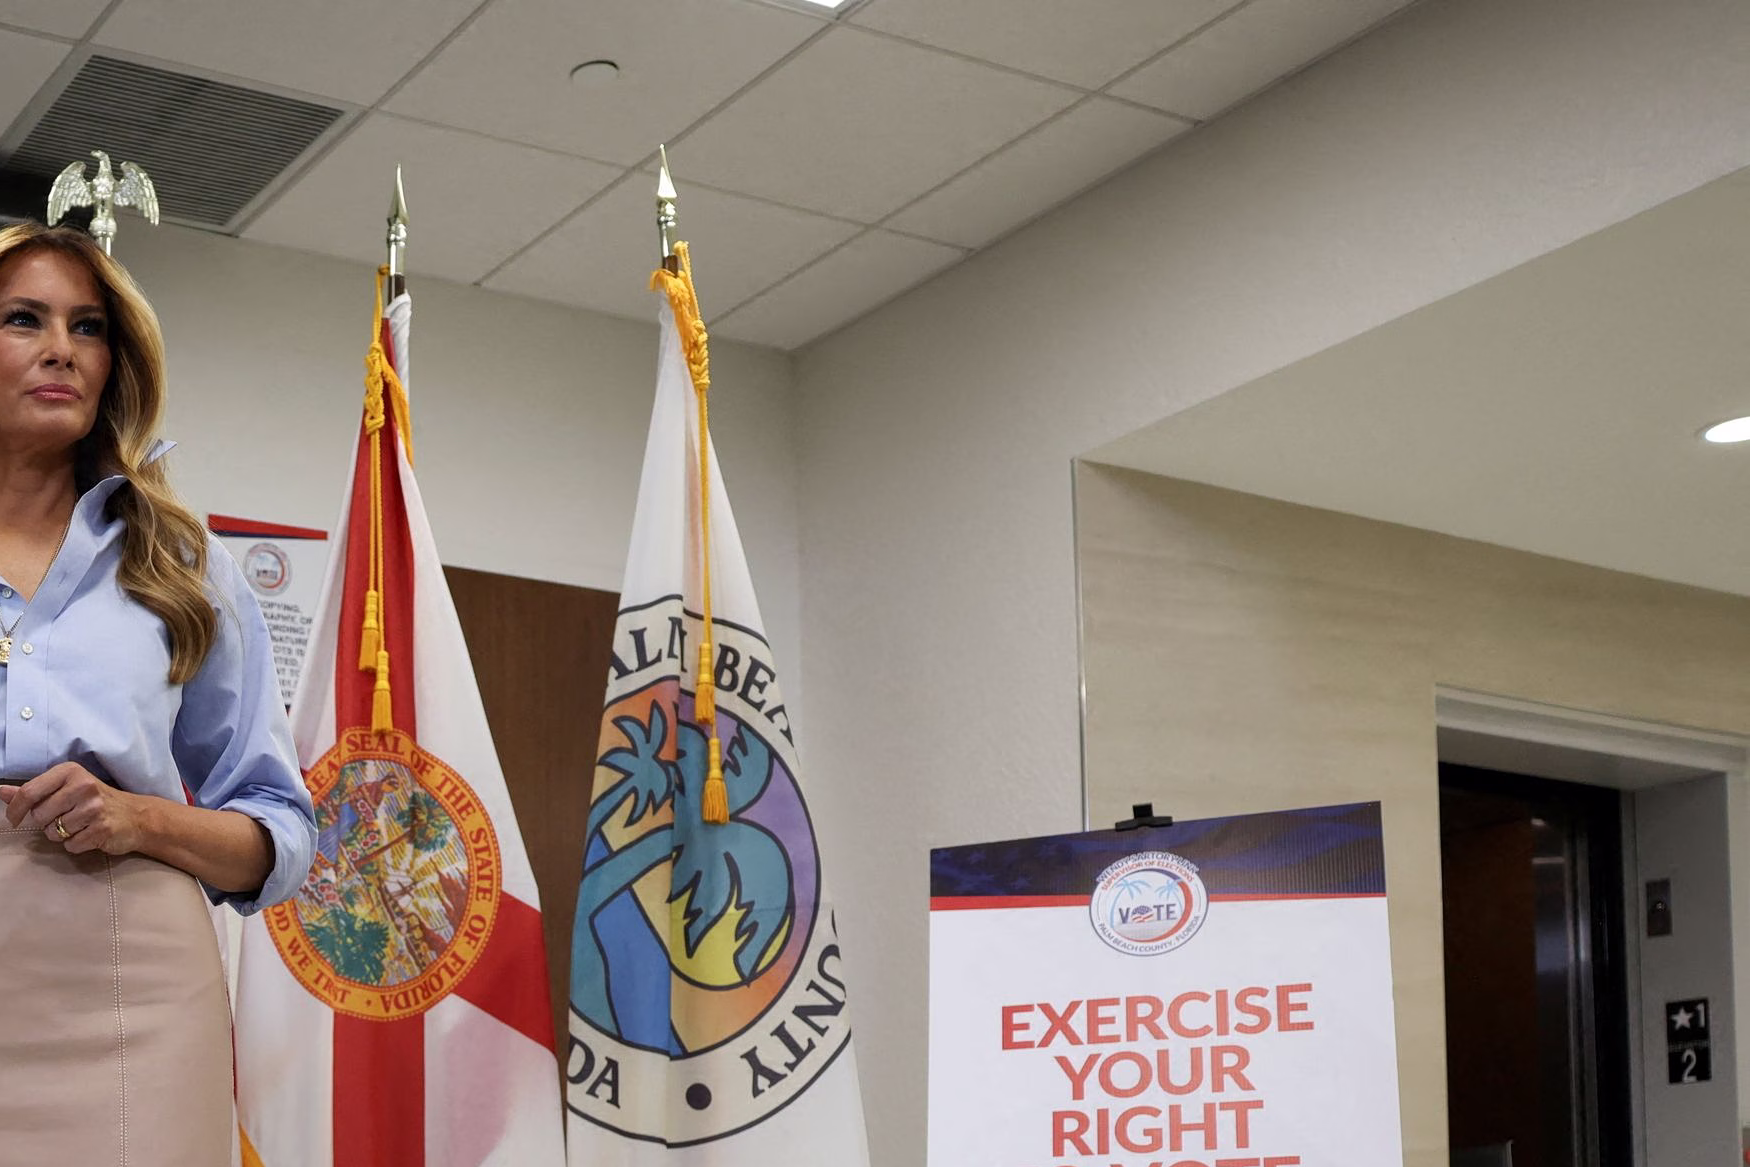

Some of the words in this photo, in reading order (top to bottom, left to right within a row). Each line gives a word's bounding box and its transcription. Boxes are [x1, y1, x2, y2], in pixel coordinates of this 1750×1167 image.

[345, 733, 404, 755] SEAL
[410, 750, 435, 774] OF
[436, 772, 476, 821] THE
[469, 827, 494, 902] STATE
[1144, 860, 1156, 868] OF
[461, 914, 487, 949] OF
[1098, 922, 1114, 940] PALM
[1112, 937, 1138, 953] BEACH
[1176, 915, 1200, 942] FLORIDA
[1118, 903, 1178, 925] VOTE
[272, 903, 290, 932] OD
[287, 938, 313, 972] WE
[313, 969, 350, 1004] TRST
[381, 950, 467, 1013] FLORIDA
[740, 908, 848, 1098] UNTY
[1001, 983, 1316, 1051] EXERCISE
[1696, 1003, 1706, 1028] 1
[1053, 1045, 1256, 1101] YOUR
[1681, 1049, 1698, 1083] 2
[1052, 1100, 1264, 1157] RIGHT
